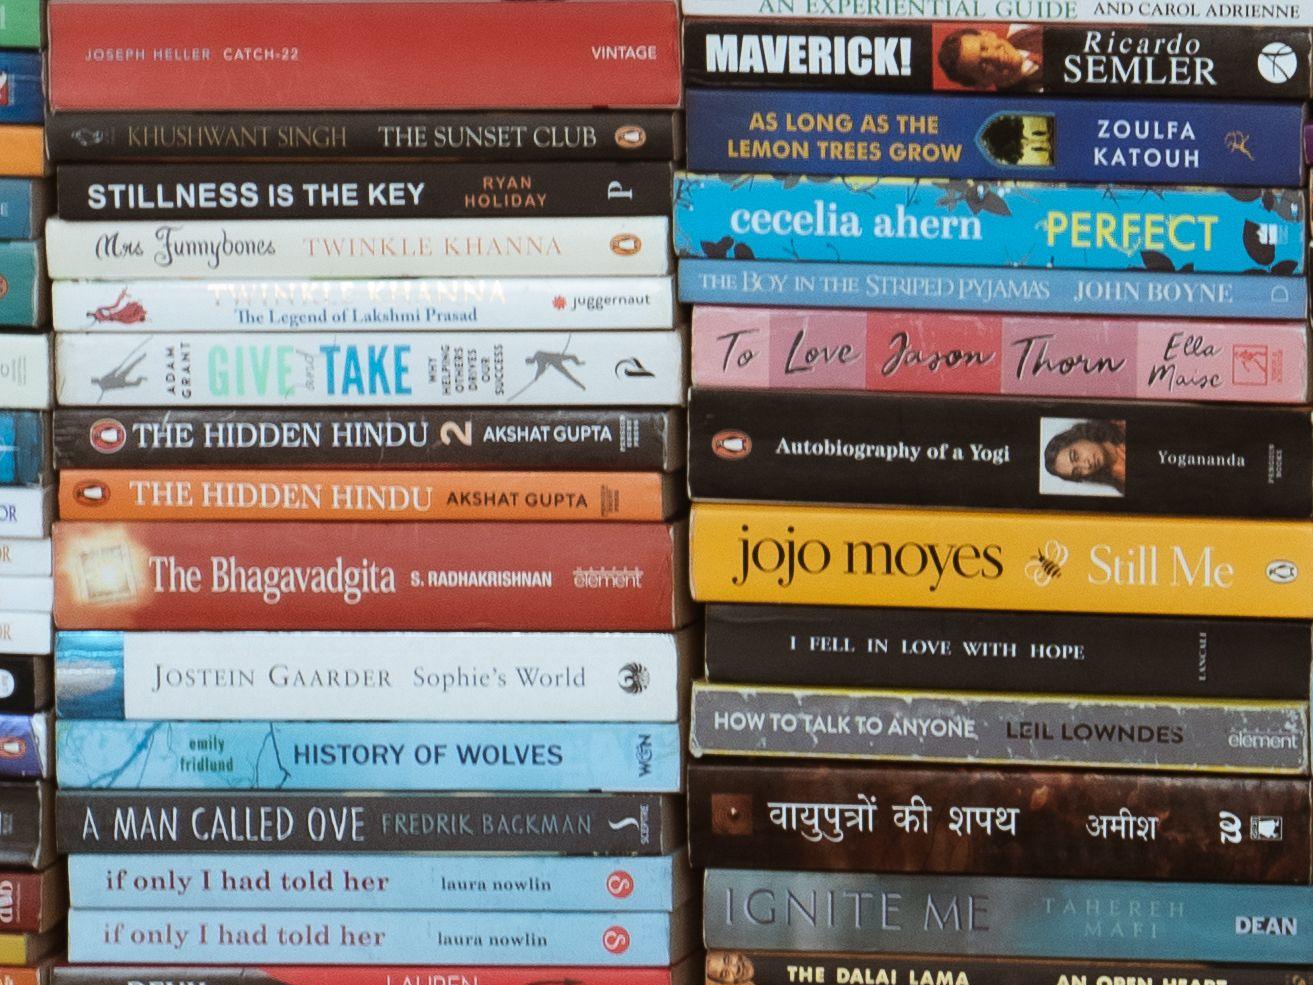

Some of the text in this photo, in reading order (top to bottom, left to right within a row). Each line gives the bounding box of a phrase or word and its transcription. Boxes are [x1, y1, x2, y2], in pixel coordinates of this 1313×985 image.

[591, 45, 657, 61] VINTAGE
[1084, 31, 1201, 55] Ricardo
[84, 48, 300, 61] JOSEPH HELLER CATCH-22
[705, 36, 912, 76] MAVERICK!
[1063, 57, 1217, 86] SEMLER
[1097, 119, 1195, 141] ZOULFA
[1093, 145, 1200, 168] KATOUH
[482, 176, 532, 191] RYAN
[464, 193, 547, 209] HOLIDAY
[234, 307, 478, 327] The Legend of Lakshmi Prasad
[483, 426, 549, 442] AKSHAT
[553, 425, 612, 442] GUPTA
[1158, 449, 1246, 468] Yogananda
[294, 743, 564, 766] HISTORY OF WOLVES
[767, 794, 1019, 842] वायुपुत्रों की शपथ
[1085, 807, 1158, 842] अमीश
[440, 875, 552, 892] laura nowlin
